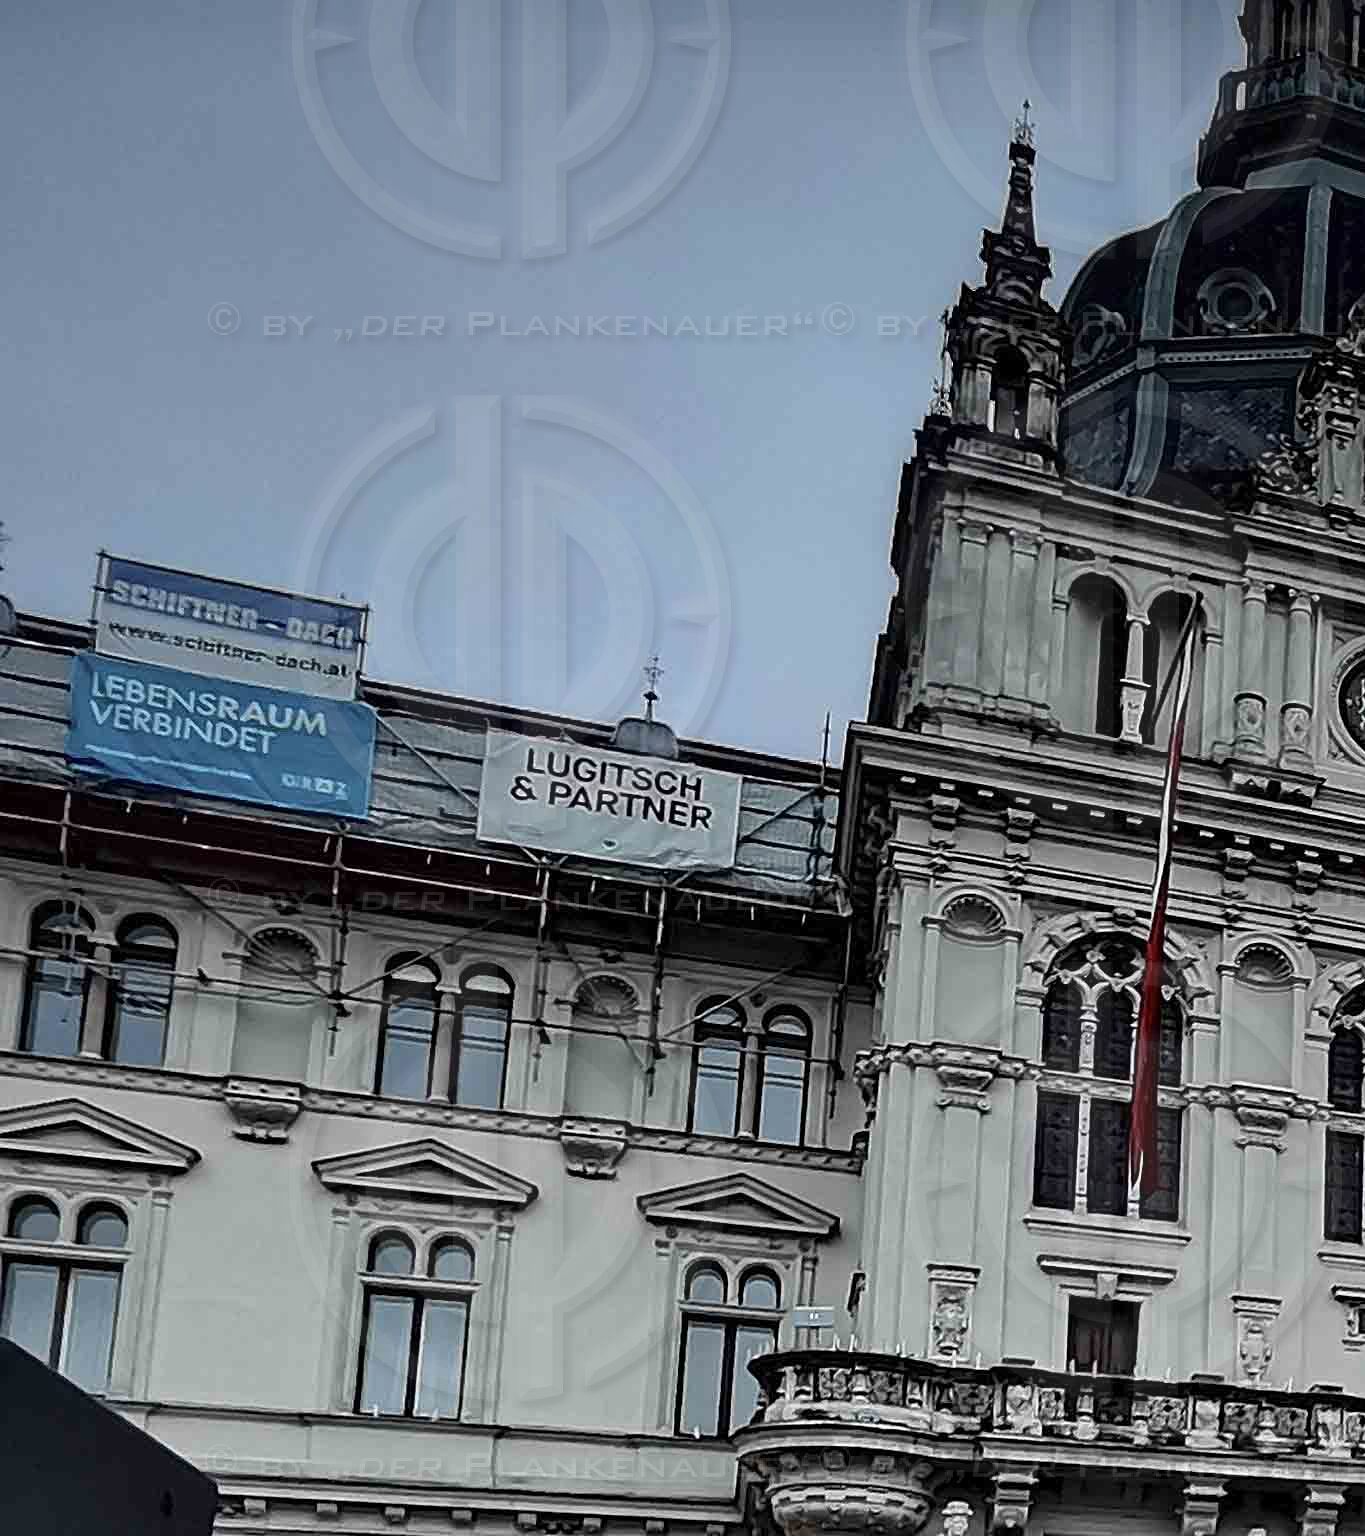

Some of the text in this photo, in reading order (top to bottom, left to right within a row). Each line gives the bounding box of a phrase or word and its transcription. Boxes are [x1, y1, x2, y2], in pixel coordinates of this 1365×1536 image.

[90, 700, 278, 755] VERBINDET
[91, 671, 327, 737] LEBENSRAUM
[526, 748, 702, 801] LUGITSCH
[510, 775, 713, 830] & PARTNER
